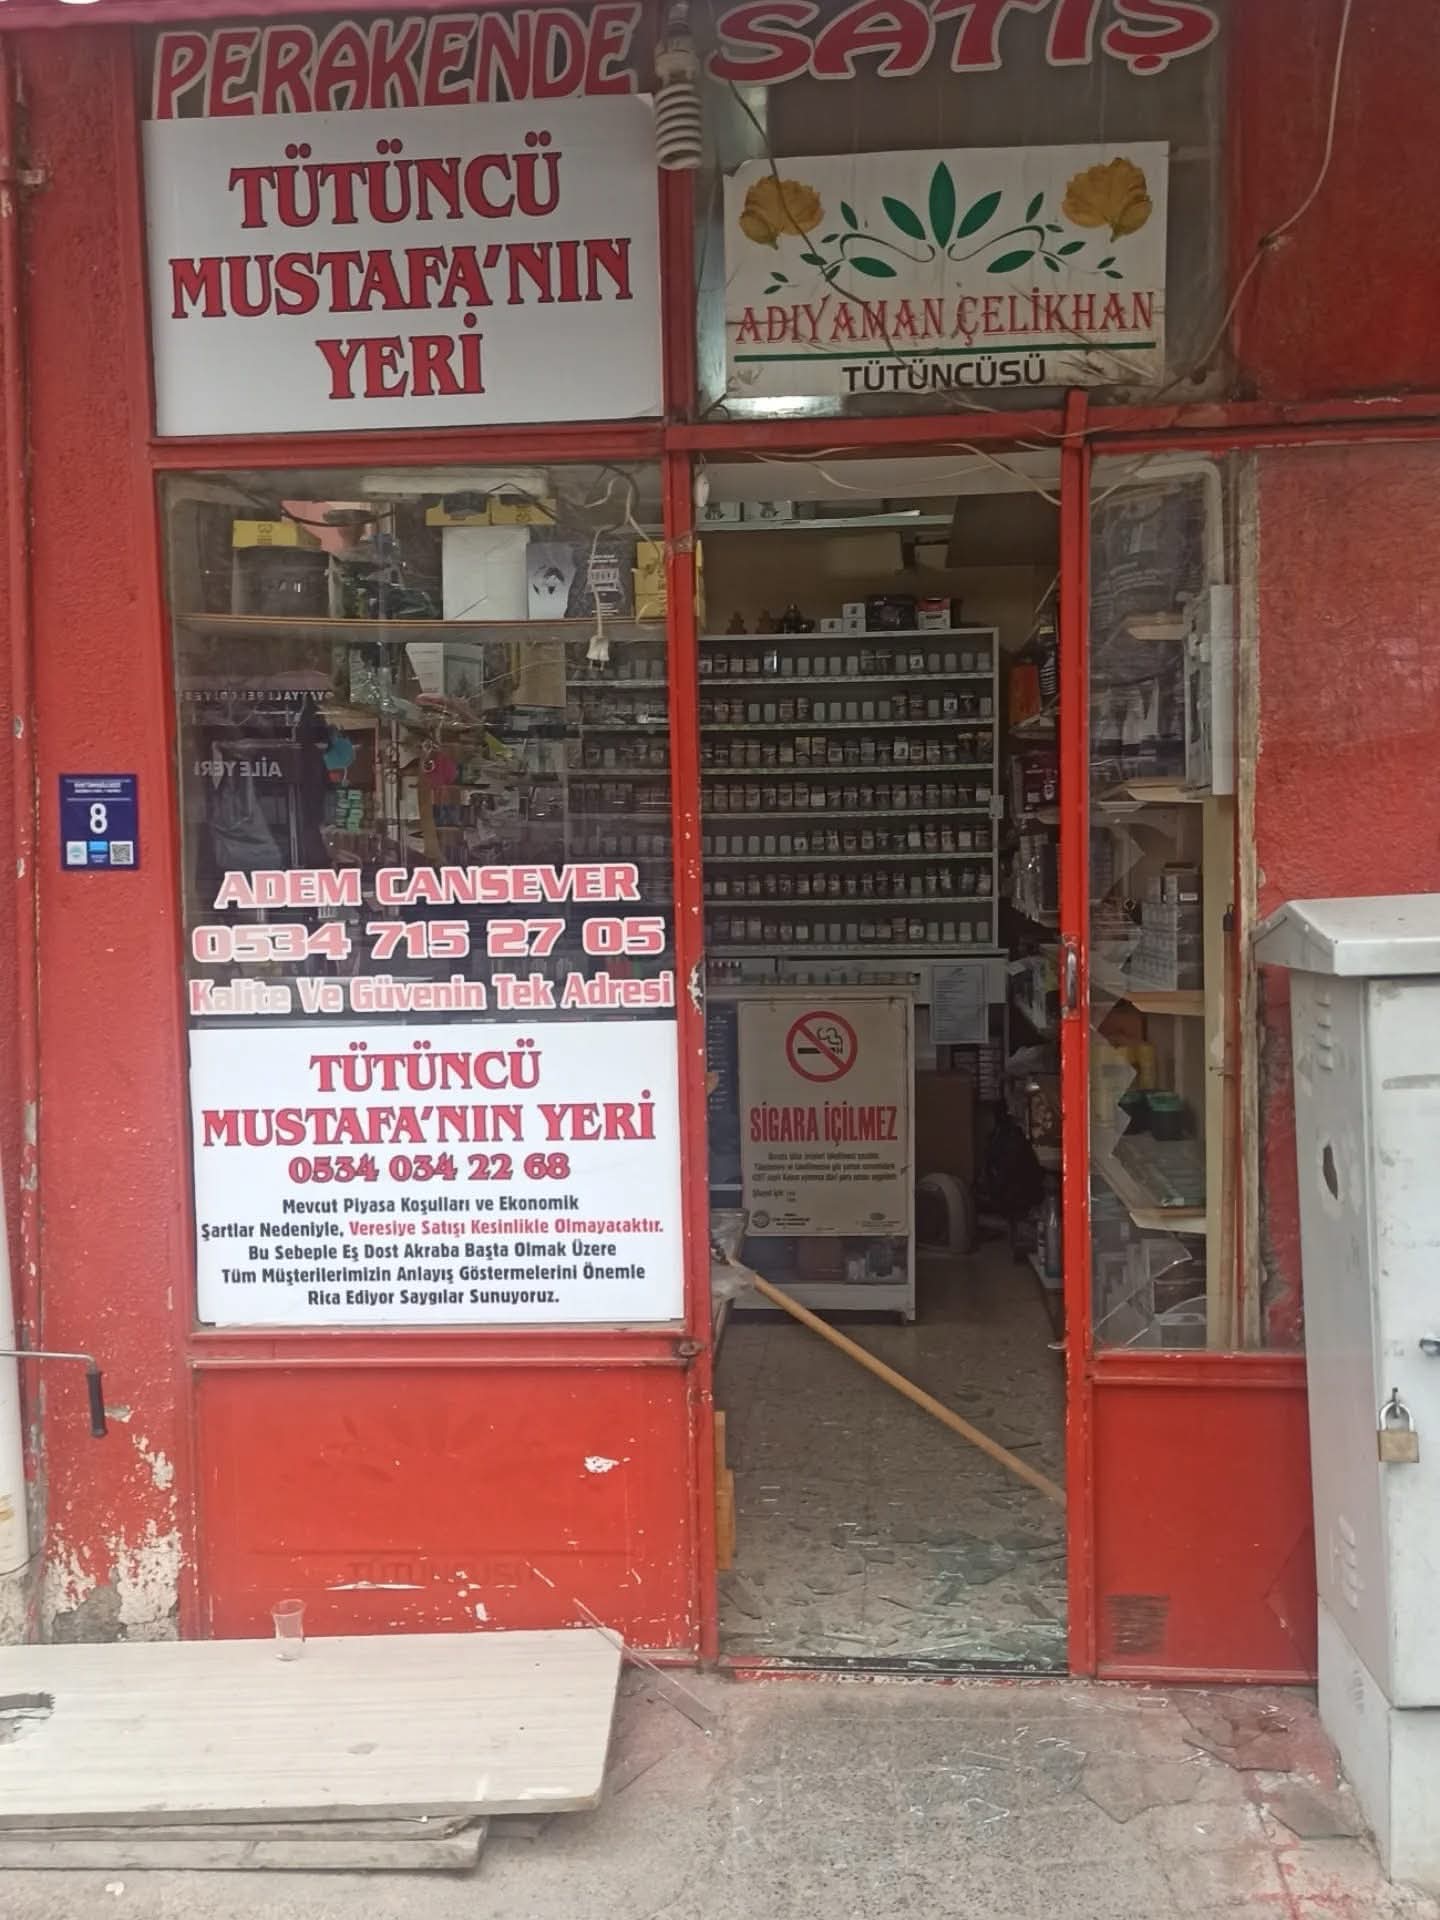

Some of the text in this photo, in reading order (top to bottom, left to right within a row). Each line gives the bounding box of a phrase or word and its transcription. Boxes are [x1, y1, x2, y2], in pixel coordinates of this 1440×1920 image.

[154, 0, 1219, 119] PERAKENDE SATIŞ
[228, 130, 562, 229] TÜTÜNCÜ
[169, 237, 633, 319] MUSTAFA'NIN
[735, 287, 1155, 346] ADIYAMAN ÇELİKHAN
[316, 312, 485, 400] YERİ
[842, 353, 1046, 393] TÜTÜNCÜSÜ
[90, 803, 108, 834] 8
[214, 864, 641, 909] ADEM CANSEVER
[192, 917, 666, 962] 0534 715 27 05
[190, 970, 675, 1015] Kalite Ve Güvenin Tek Adresi
[309, 1038, 542, 1092] TÜTÜNCÜ
[202, 1089, 656, 1147] MUSTAFA'NIN YERİ
[749, 1100, 898, 1147] SİGARA İÇİLMEZ
[288, 1152, 571, 1184] 0534 034 22 68
[282, 1195, 579, 1215] Mevcut Piyasa Koşulları ve Ekonomik
[201, 1218, 664, 1241] Şartlar Nedeniyle, Veresiye Satışı Kesinlikle Olmayacaktır.
[249, 1238, 617, 1262] Bu Sebeple Eş Dost Akraba Başta Olmak Üzere
[222, 1261, 646, 1285] Tüm Müşterilerimizin Anlayış Göstermelerini Önemle
[308, 1288, 560, 1305] Rica Ediyor Saygılar Sunuyoruz.
